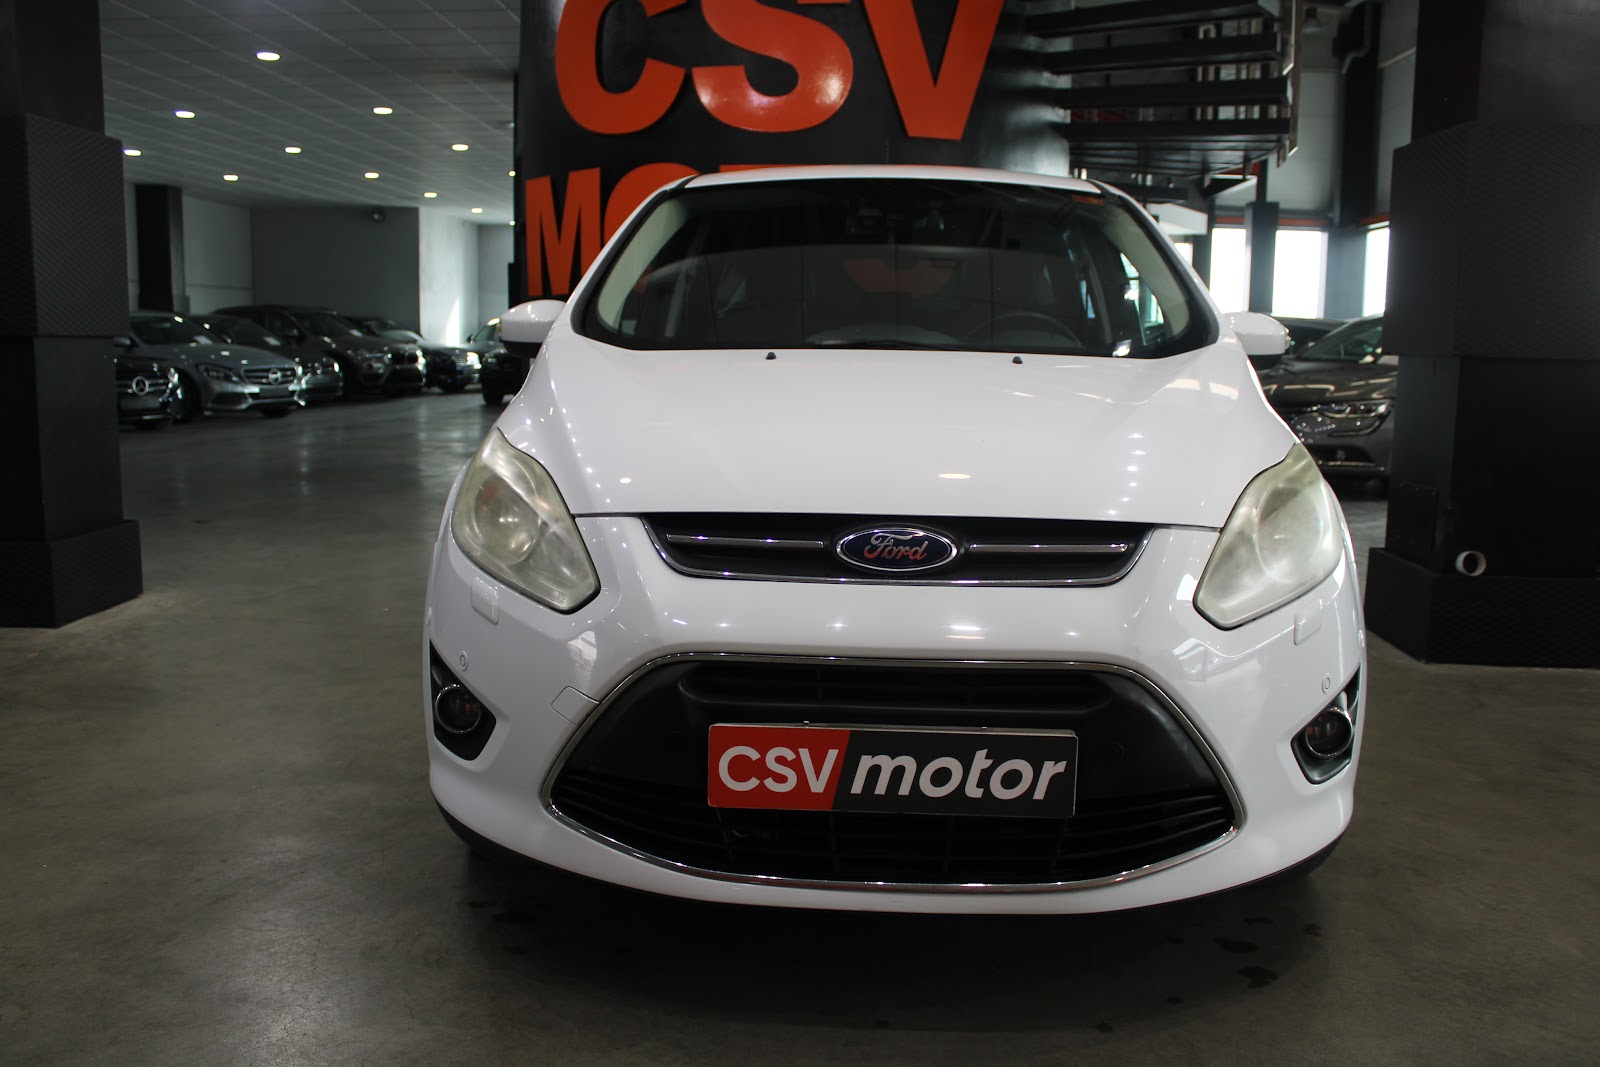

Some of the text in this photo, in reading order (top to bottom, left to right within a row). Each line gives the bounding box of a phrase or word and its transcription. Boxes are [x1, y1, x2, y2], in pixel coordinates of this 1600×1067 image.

[555, 0, 1003, 140] CSV
[863, 532, 929, 561] Ford
[718, 745, 1067, 800] CSV motor
